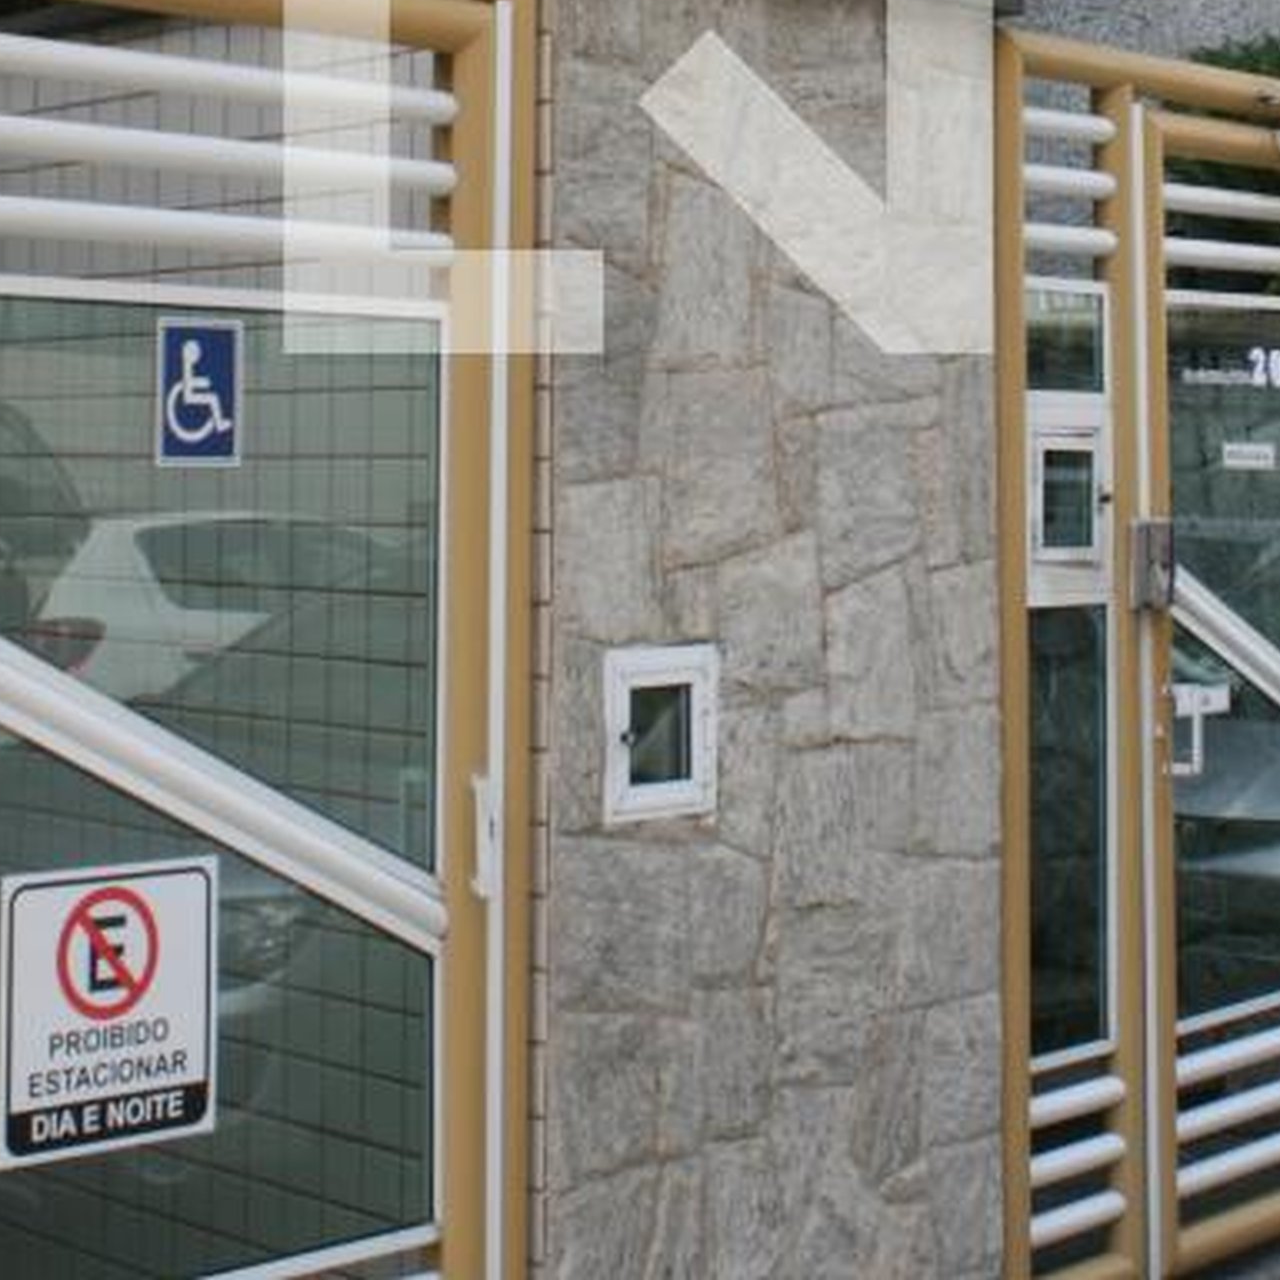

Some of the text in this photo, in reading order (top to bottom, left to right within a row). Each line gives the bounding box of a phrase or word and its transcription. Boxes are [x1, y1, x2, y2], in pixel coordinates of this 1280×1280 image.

[48, 1017, 170, 1058] PROIBIDO
[28, 1049, 188, 1098] ESTACIONAR
[31, 1090, 185, 1144] DIA E NOITE
